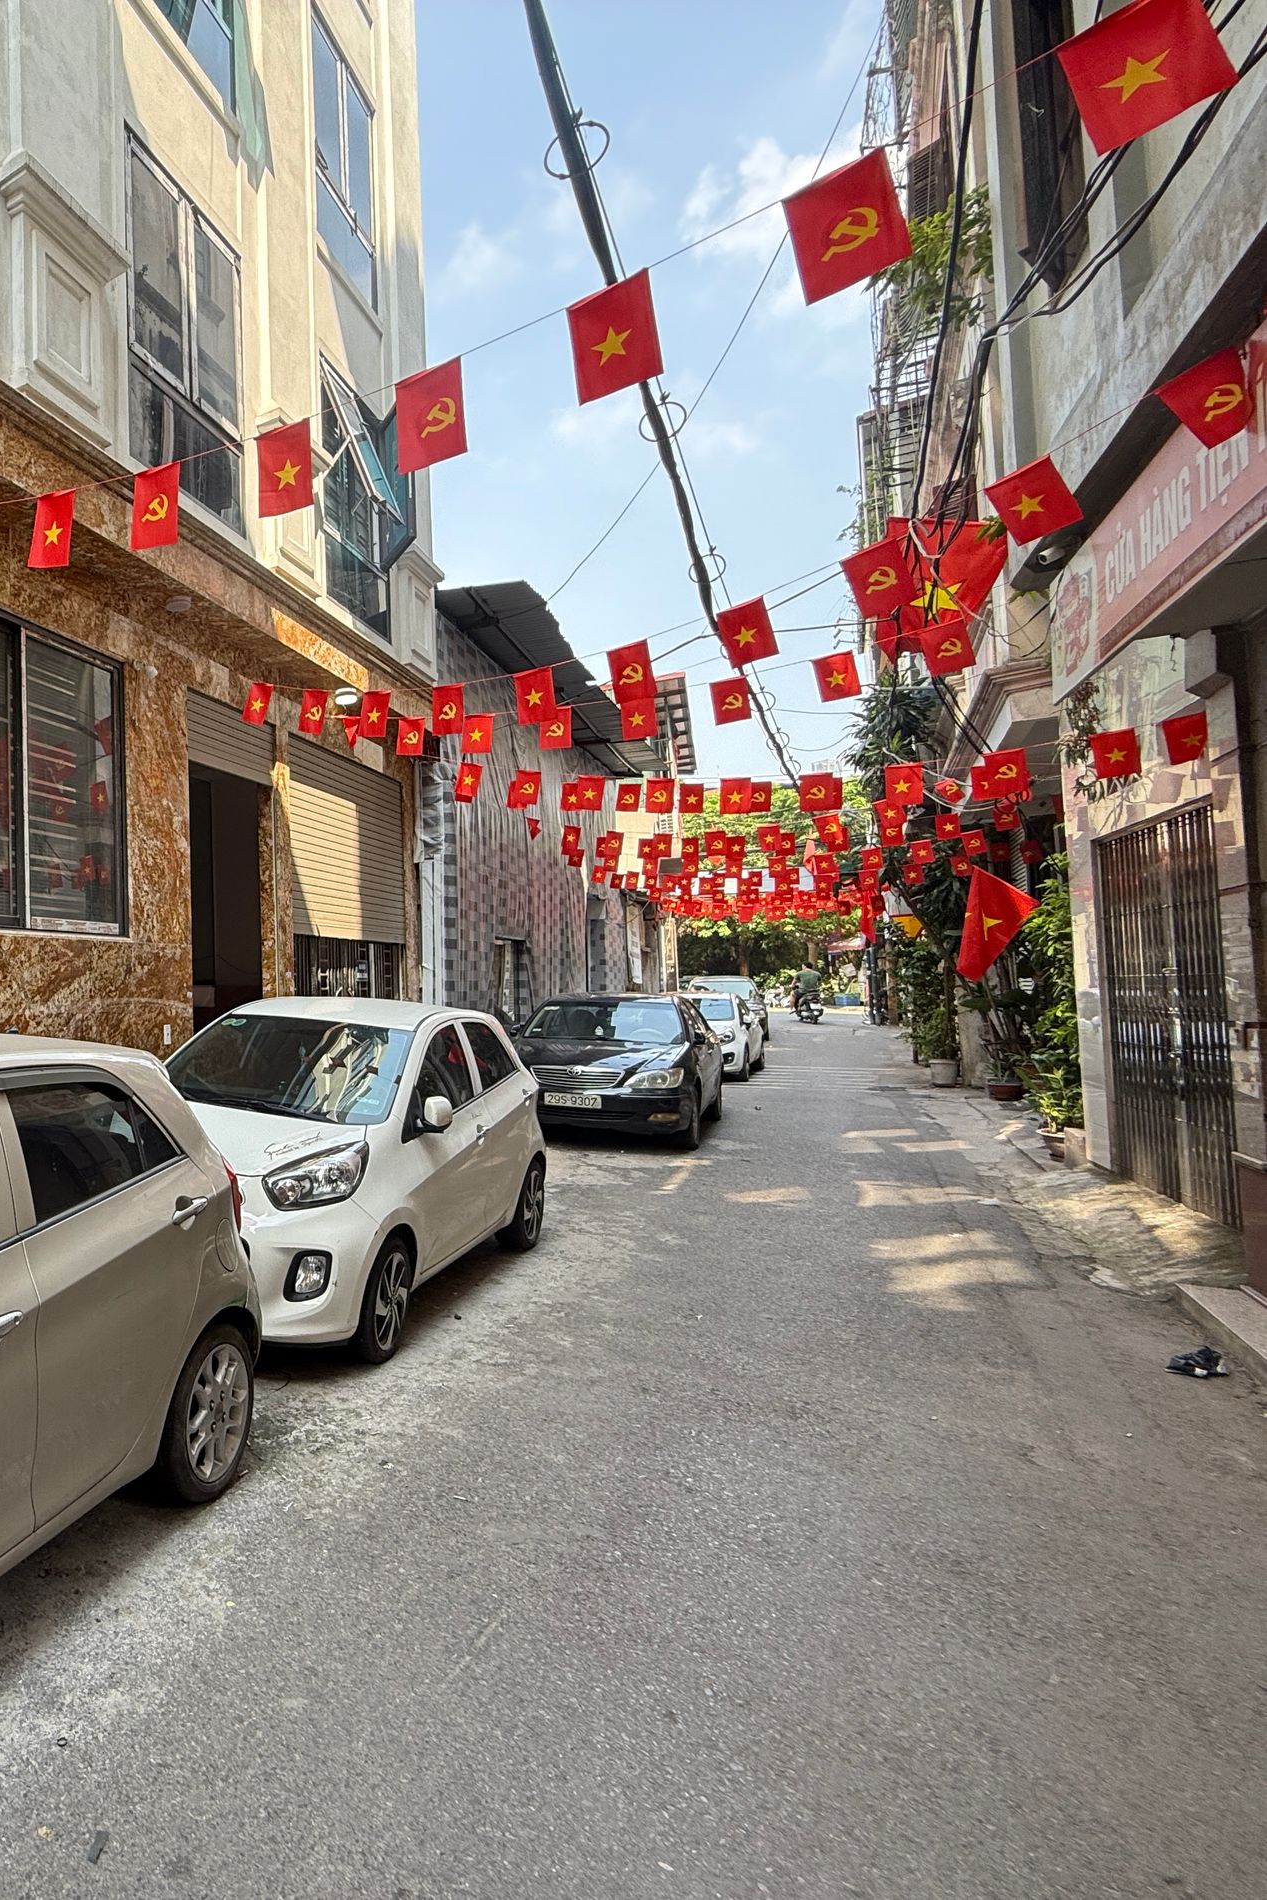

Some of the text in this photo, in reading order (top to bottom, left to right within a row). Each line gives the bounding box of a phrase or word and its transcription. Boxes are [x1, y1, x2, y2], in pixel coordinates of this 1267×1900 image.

[1105, 521, 1136, 604] CỬA
[1139, 465, 1192, 571] HÀNG
[547, 1094, 598, 1107] 29S-9307
